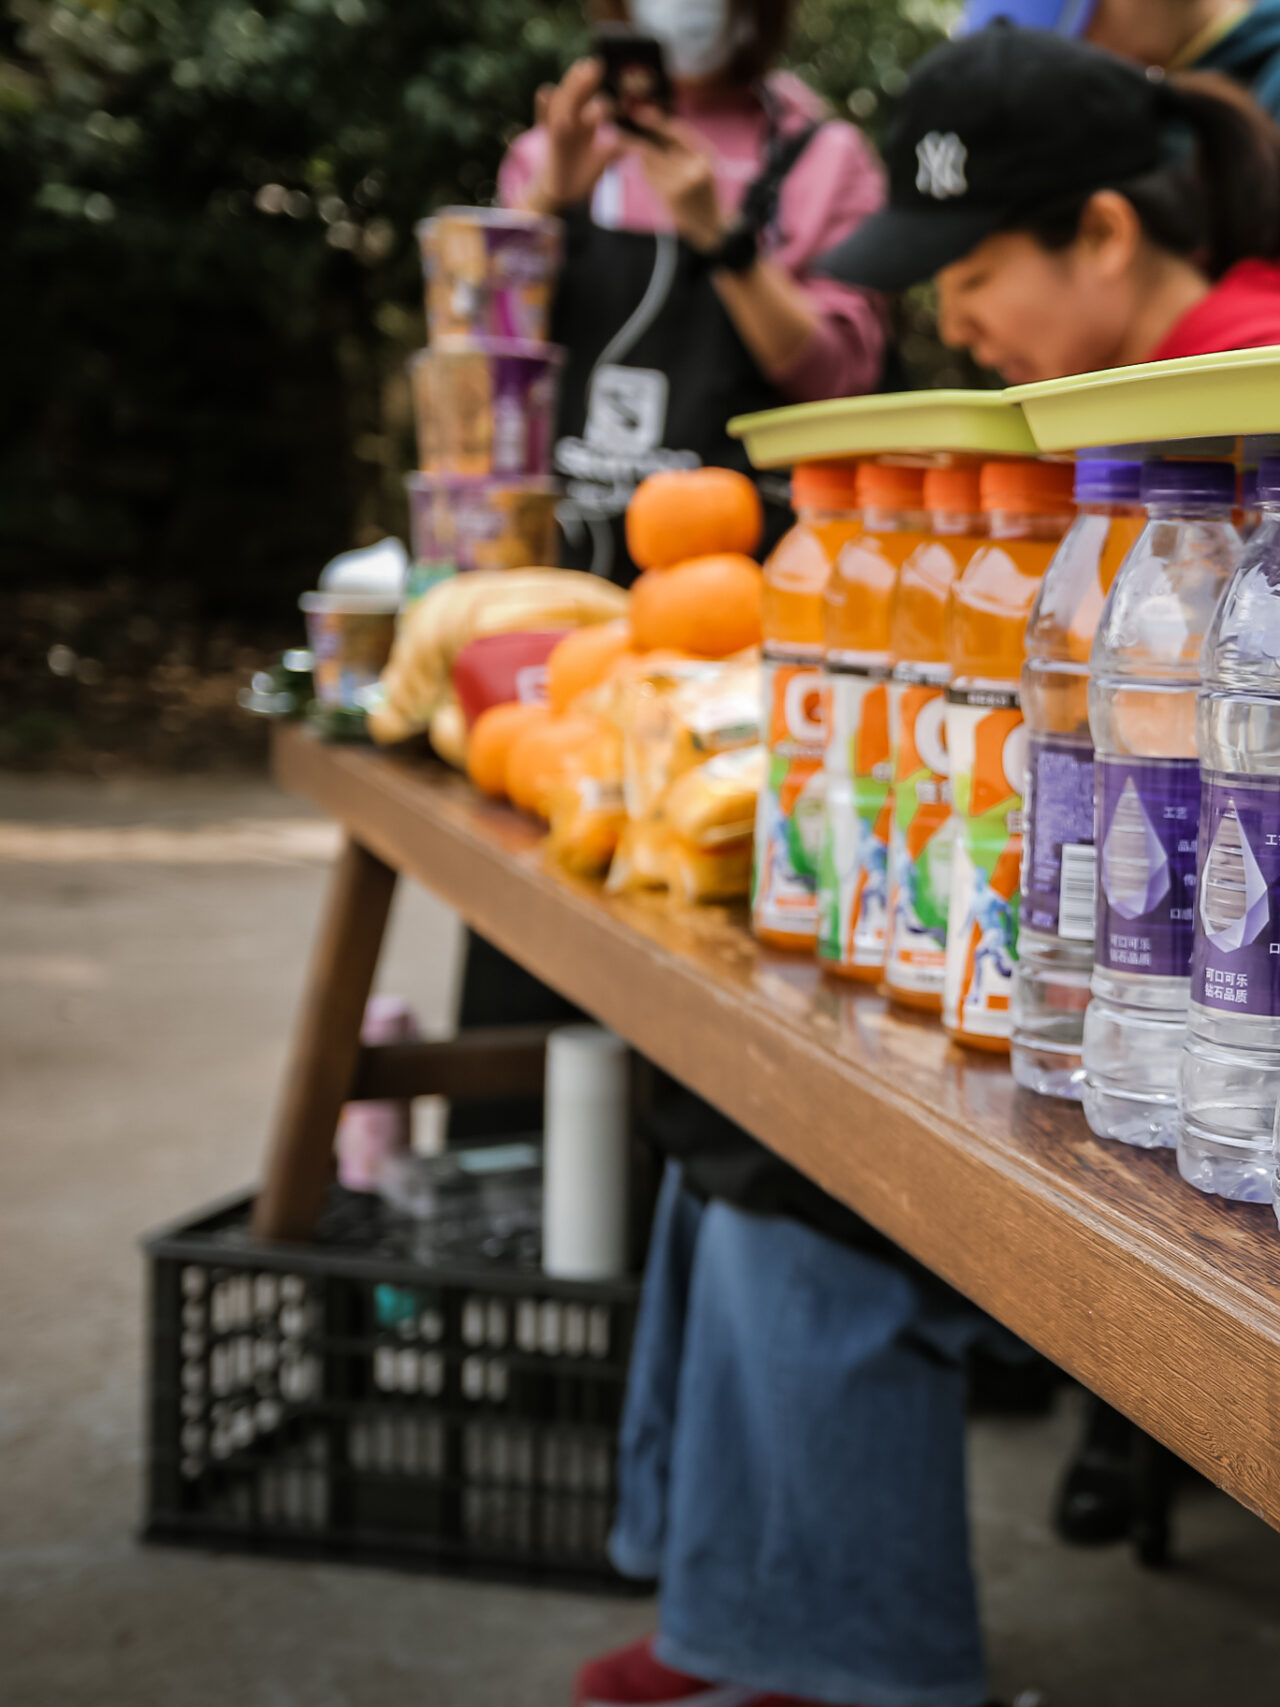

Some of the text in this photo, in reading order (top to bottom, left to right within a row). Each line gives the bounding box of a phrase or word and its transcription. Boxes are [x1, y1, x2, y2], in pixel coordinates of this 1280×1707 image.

[1205, 967, 1248, 988] 可口可乐
[1204, 982, 1248, 1004] 钻石品质
